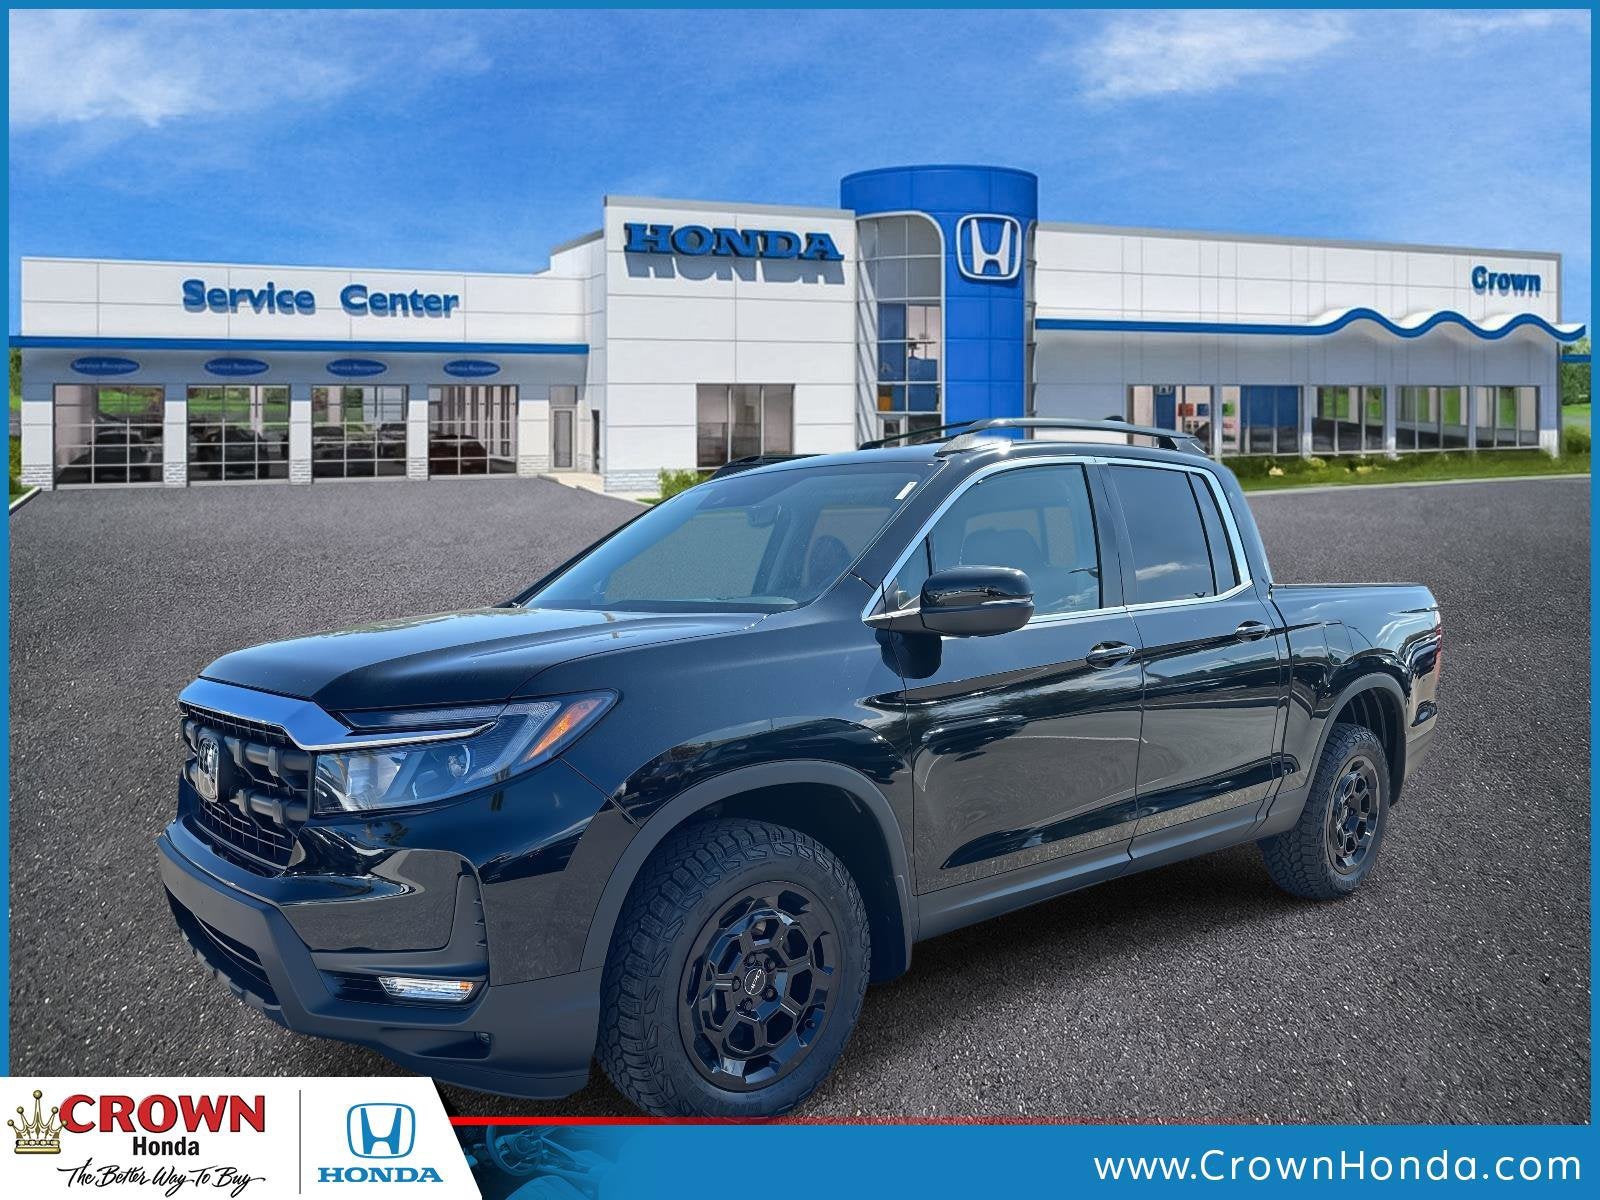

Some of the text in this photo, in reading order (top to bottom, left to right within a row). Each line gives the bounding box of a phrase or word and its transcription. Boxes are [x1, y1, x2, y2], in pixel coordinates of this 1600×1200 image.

[625, 223, 844, 262] HONDA
[183, 279, 459, 315] Service Center
[1472, 266, 1541, 293] Crown
